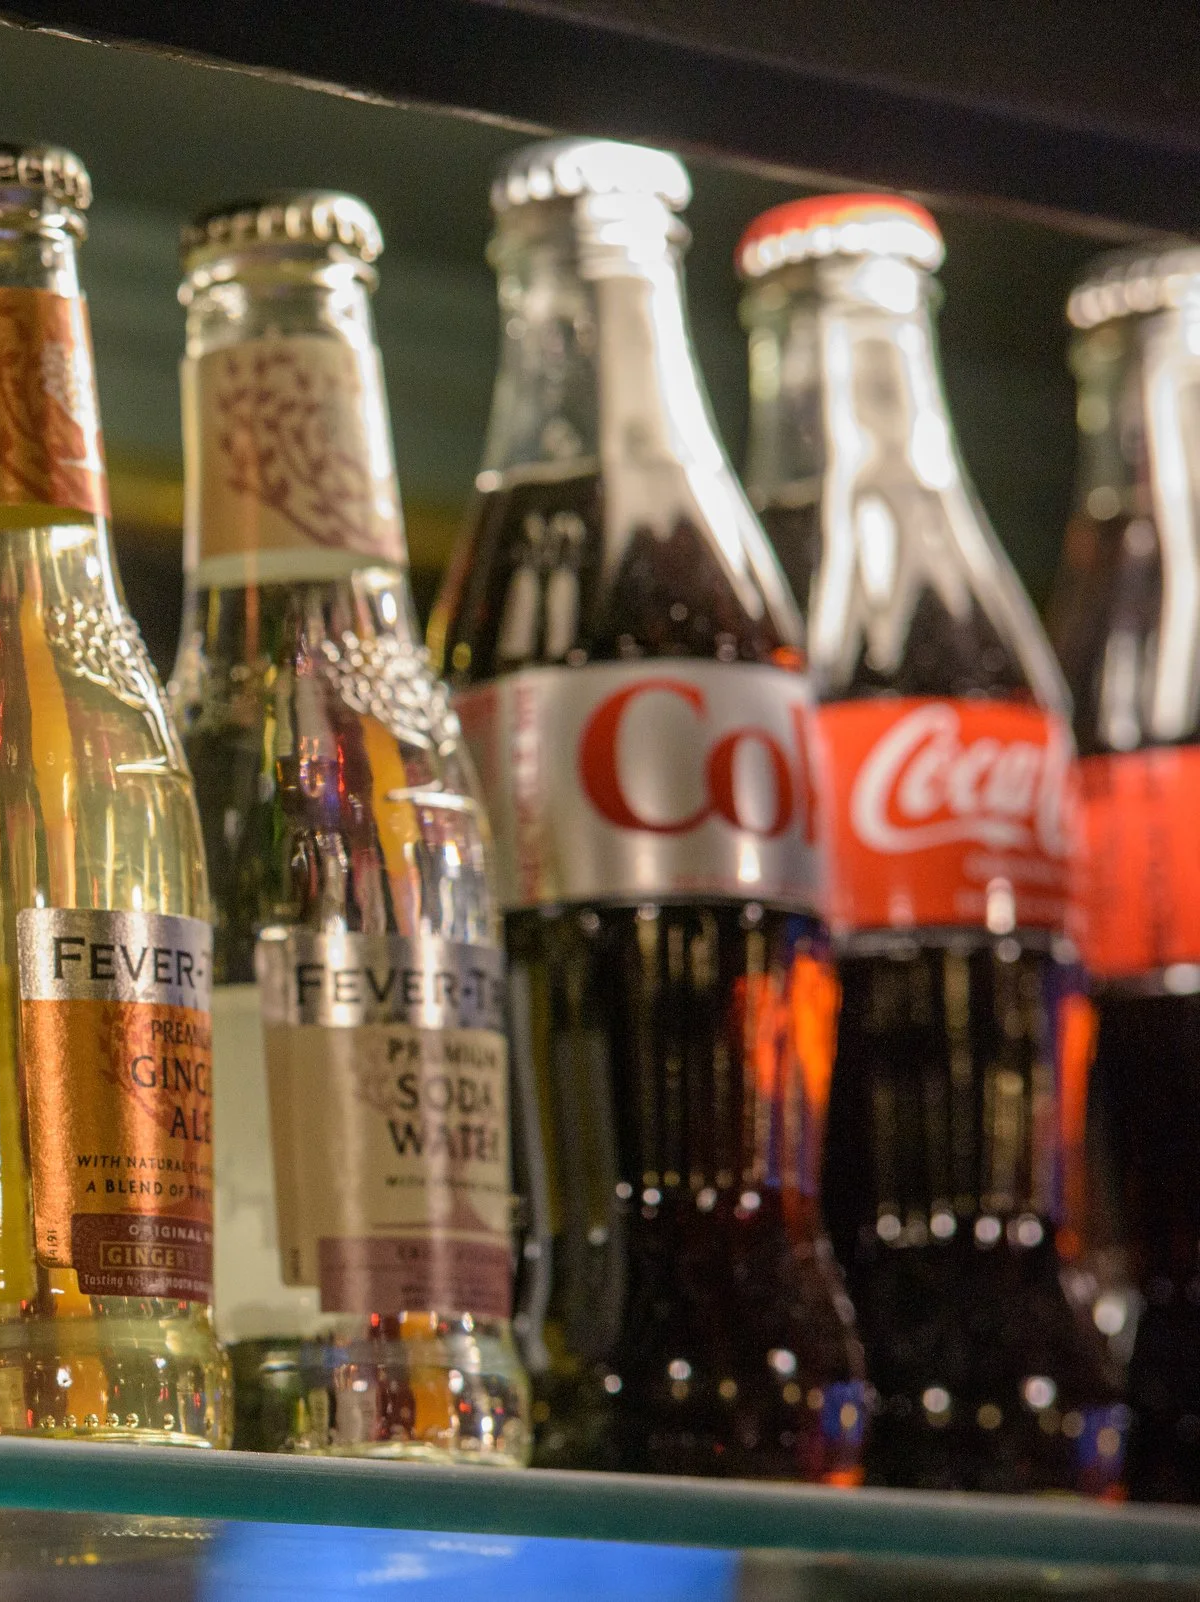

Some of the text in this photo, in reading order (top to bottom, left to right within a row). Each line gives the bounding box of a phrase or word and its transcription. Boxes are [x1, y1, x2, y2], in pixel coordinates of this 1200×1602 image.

[52, 936, 211, 989] FEVER-
[77, 1155, 121, 1169] WITH
[126, 1156, 188, 1173] NATURAL
[86, 1180, 96, 1193] A
[105, 1178, 163, 1195] BLEND
[169, 1184, 184, 1197] OF
[128, 1223, 201, 1243] ORIGINAL
[83, 1273, 124, 1289] Tasting
